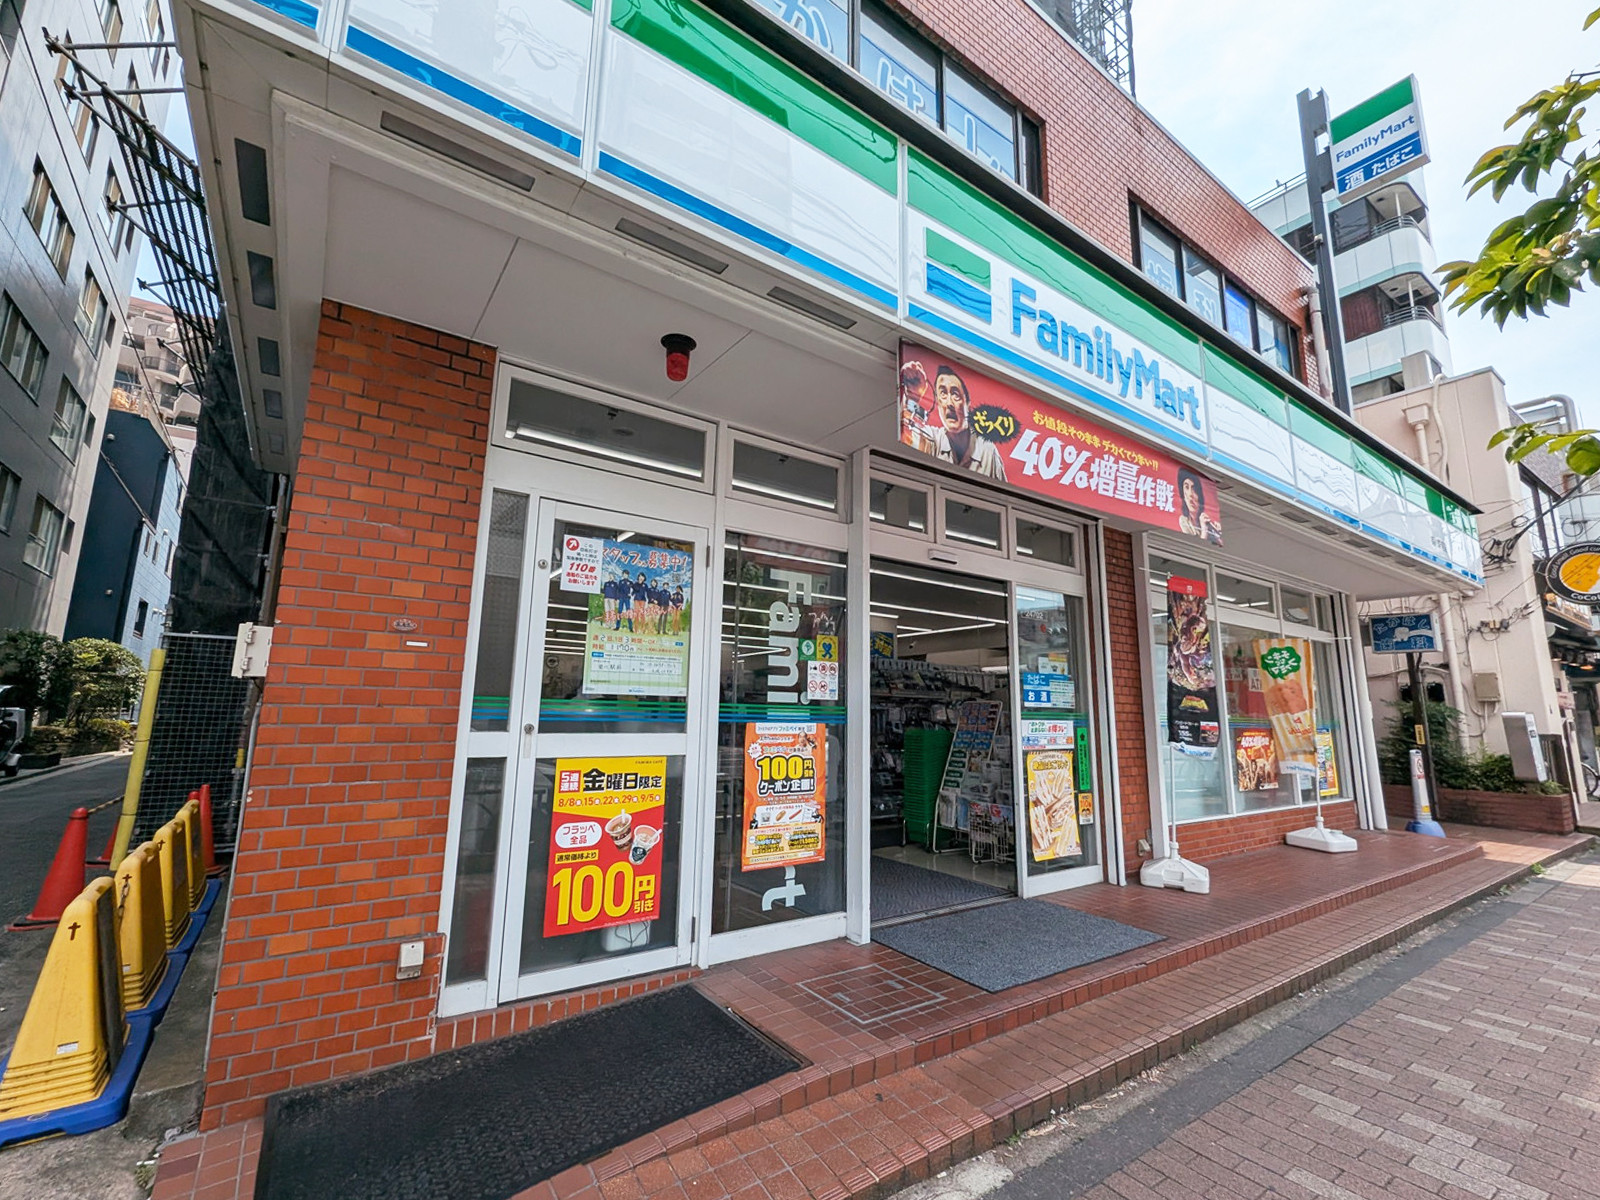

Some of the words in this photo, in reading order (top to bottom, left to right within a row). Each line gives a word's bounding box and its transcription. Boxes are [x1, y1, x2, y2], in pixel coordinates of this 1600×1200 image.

[1336, 115, 1415, 162] FamilyMart
[1345, 169, 1365, 190] 酒
[1371, 146, 1415, 175] たばこ
[1010, 277, 1201, 430] FamilyMart
[973, 410, 1015, 437] ざっくり
[1032, 410, 1101, 448] お値段そのまま
[1009, 428, 1175, 512] 40%増量作戦
[569, 562, 596, 573] 110番
[1027, 674, 1046, 685] たばこ
[561, 772, 580, 782] 5週
[583, 767, 662, 792] 金曜日限定
[560, 781, 579, 791] 連続
[760, 778, 814, 793] クーポン企画!
[562, 824, 596, 836] フラッペ
[569, 835, 587, 846] 全品
[556, 852, 597, 863] 通常価格より
